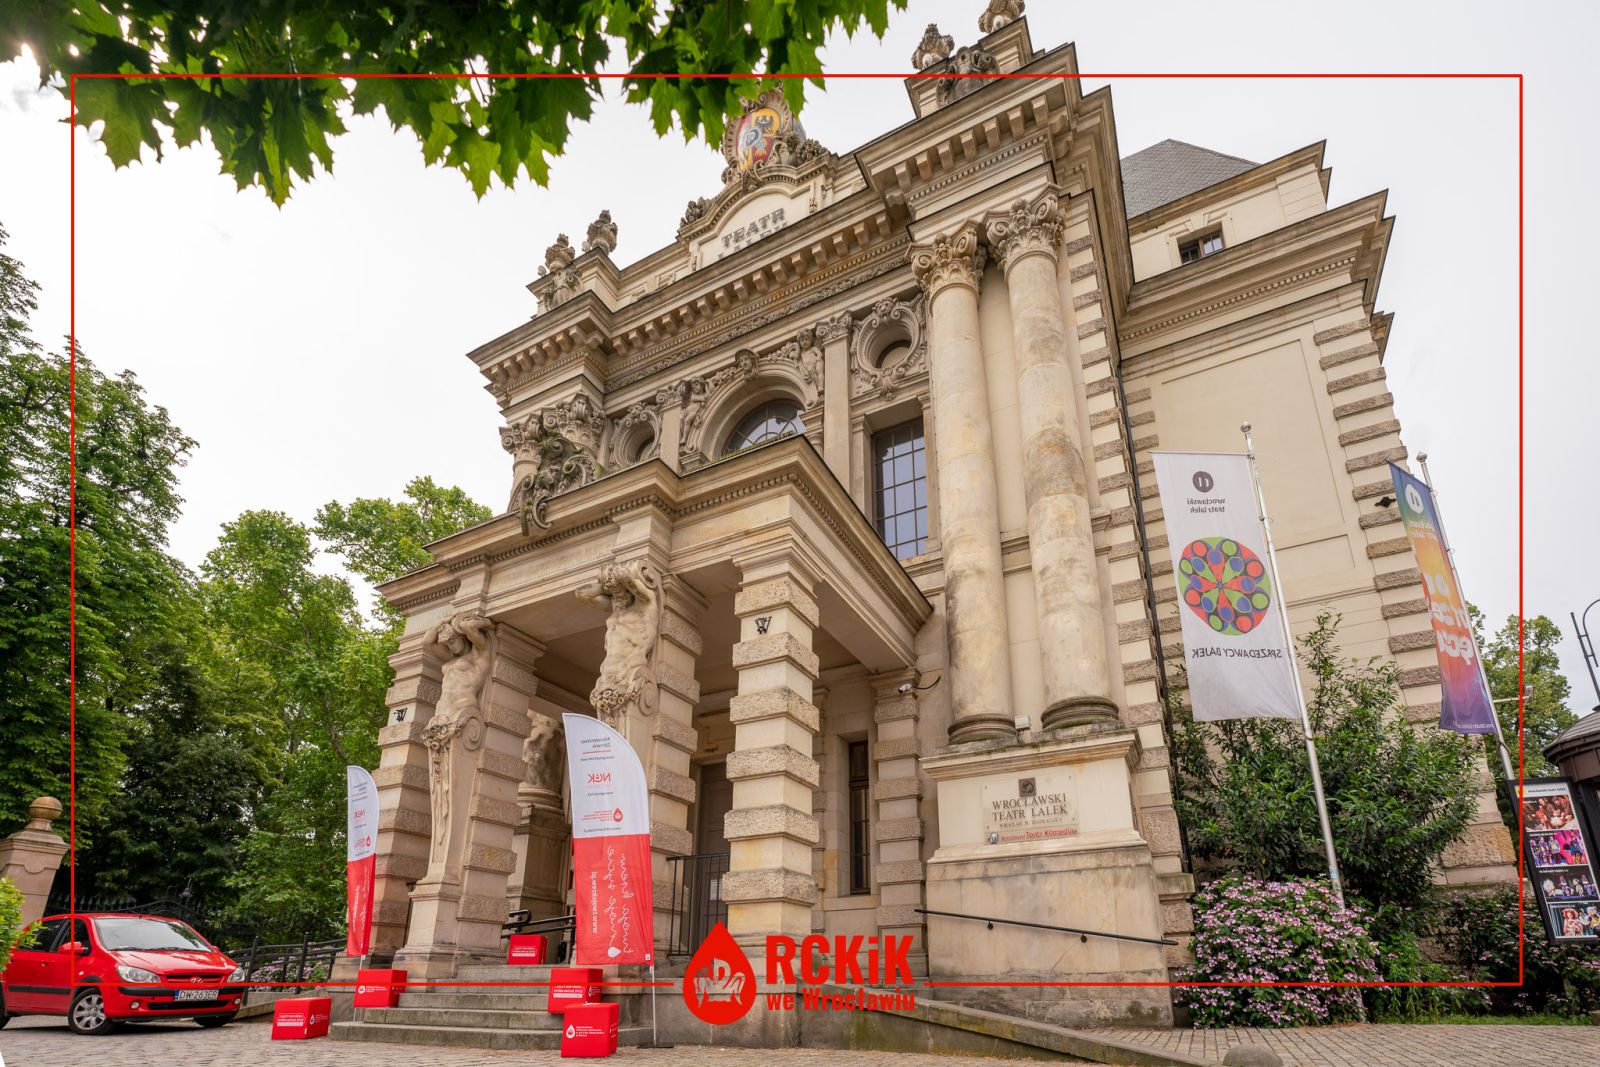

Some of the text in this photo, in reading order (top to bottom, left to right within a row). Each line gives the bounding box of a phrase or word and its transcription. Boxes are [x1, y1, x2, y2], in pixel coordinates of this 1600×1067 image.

[721, 208, 784, 248] TEATR
[992, 804, 1068, 821] TEATR LALEK
